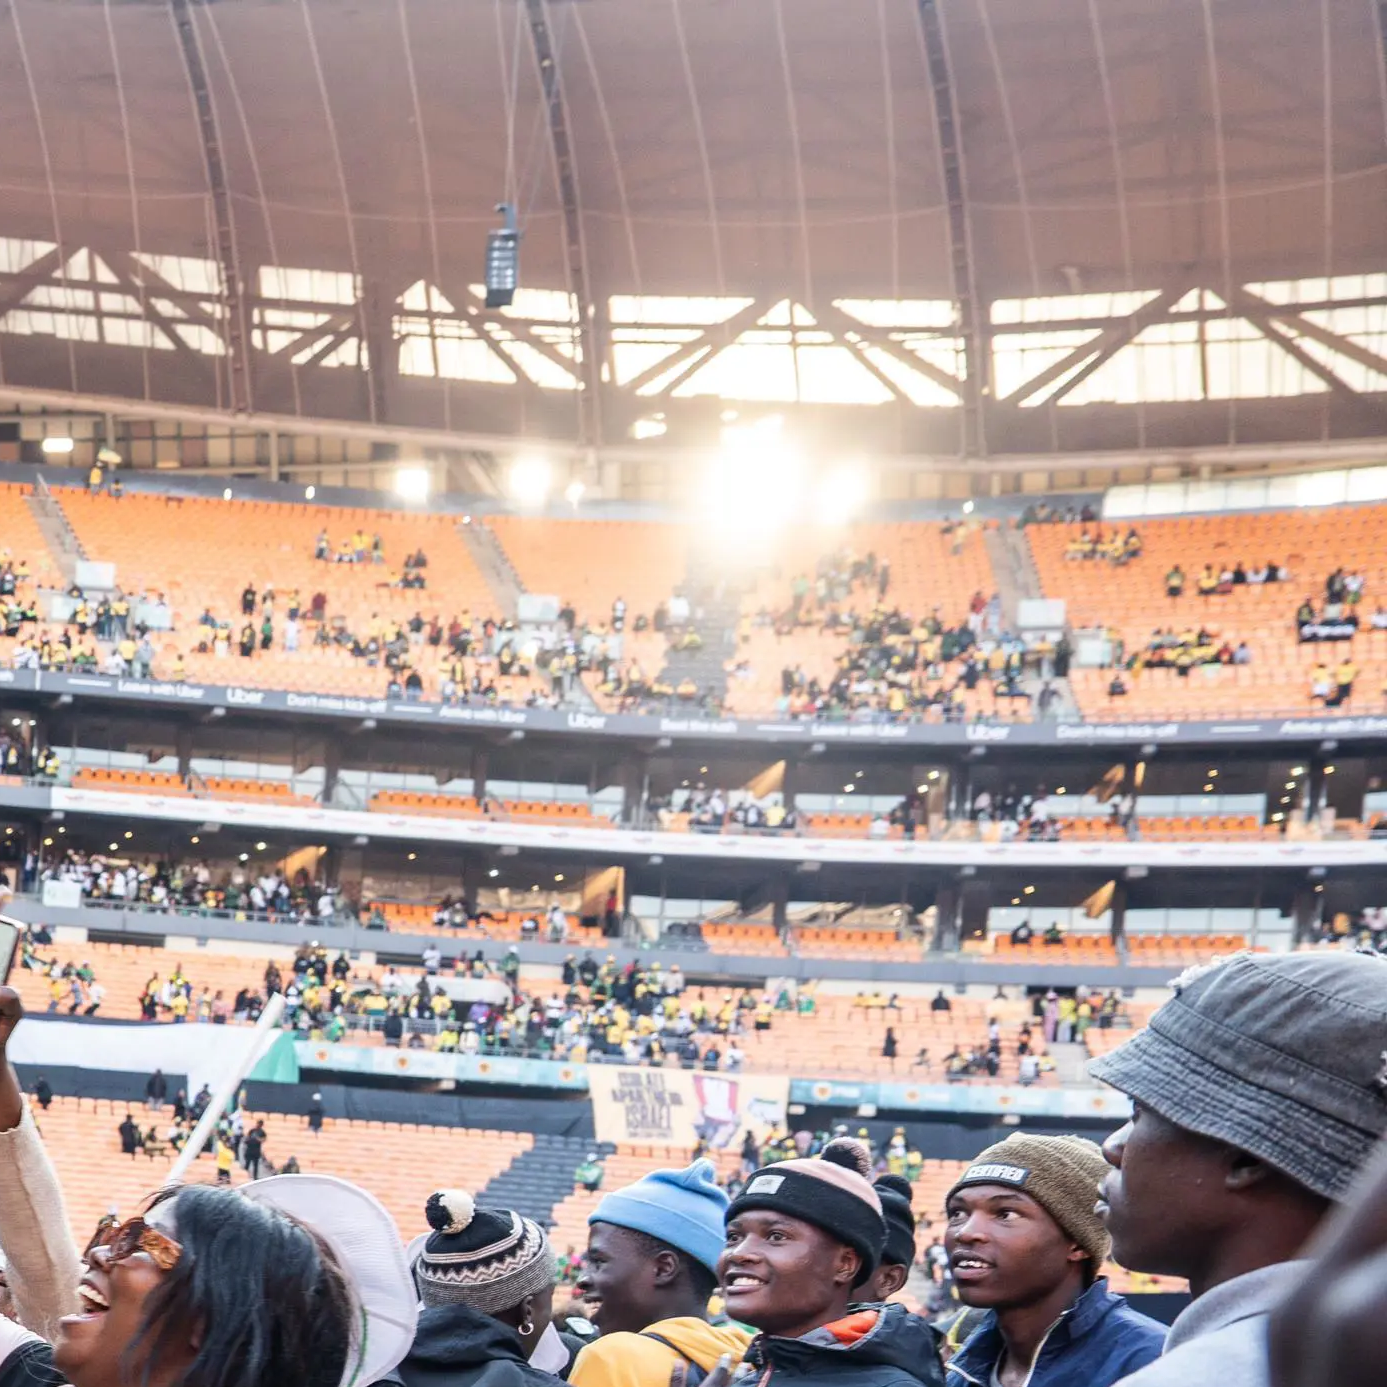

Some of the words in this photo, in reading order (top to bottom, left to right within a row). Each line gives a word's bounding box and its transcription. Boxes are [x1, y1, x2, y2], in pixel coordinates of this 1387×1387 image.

[176, 684, 205, 699] Uber
[226, 687, 265, 704] Uber
[567, 711, 606, 729] Uber
[1358, 716, 1387, 731] Ube
[966, 723, 1011, 741] Uber
[965, 1165, 1026, 1182] CERTIFIED
